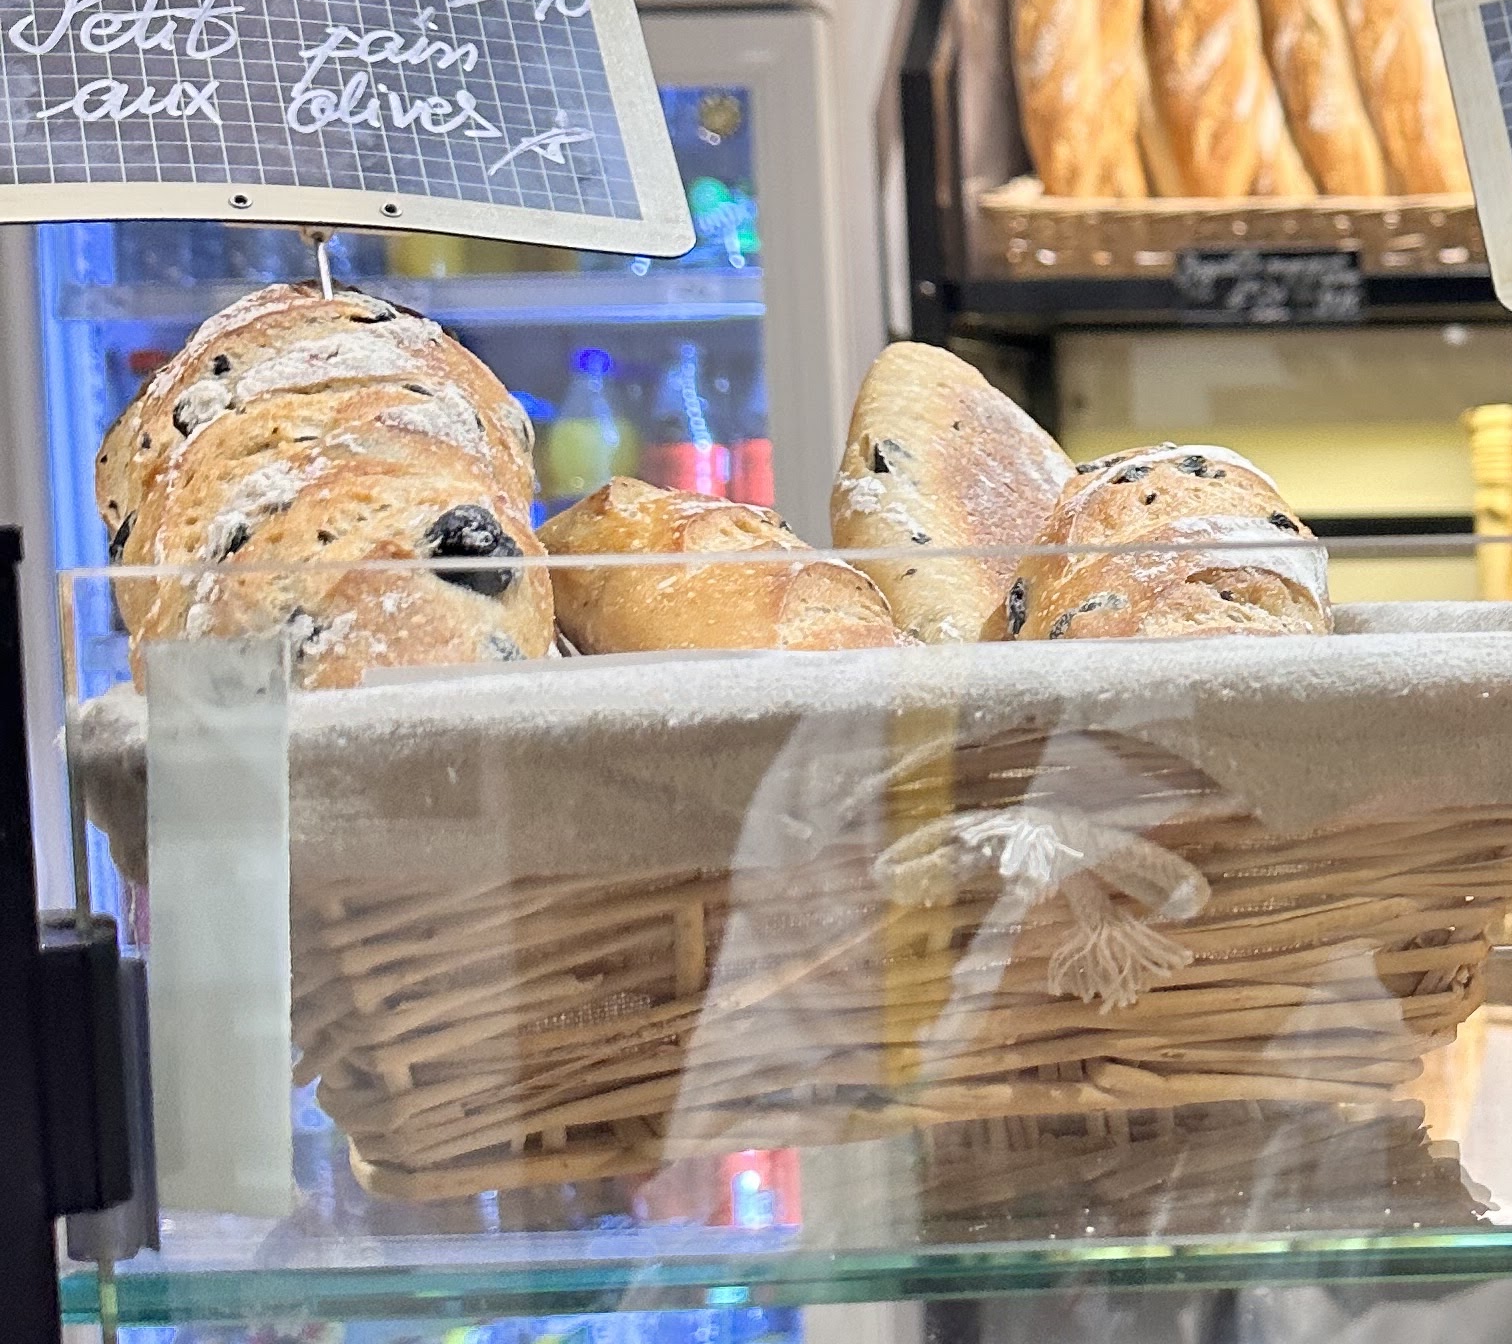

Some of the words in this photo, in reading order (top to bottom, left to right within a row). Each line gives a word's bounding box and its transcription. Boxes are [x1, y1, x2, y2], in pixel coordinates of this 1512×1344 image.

[290, 6, 479, 99] pain
[36, 77, 223, 124] aux
[287, 71, 503, 138] olives
